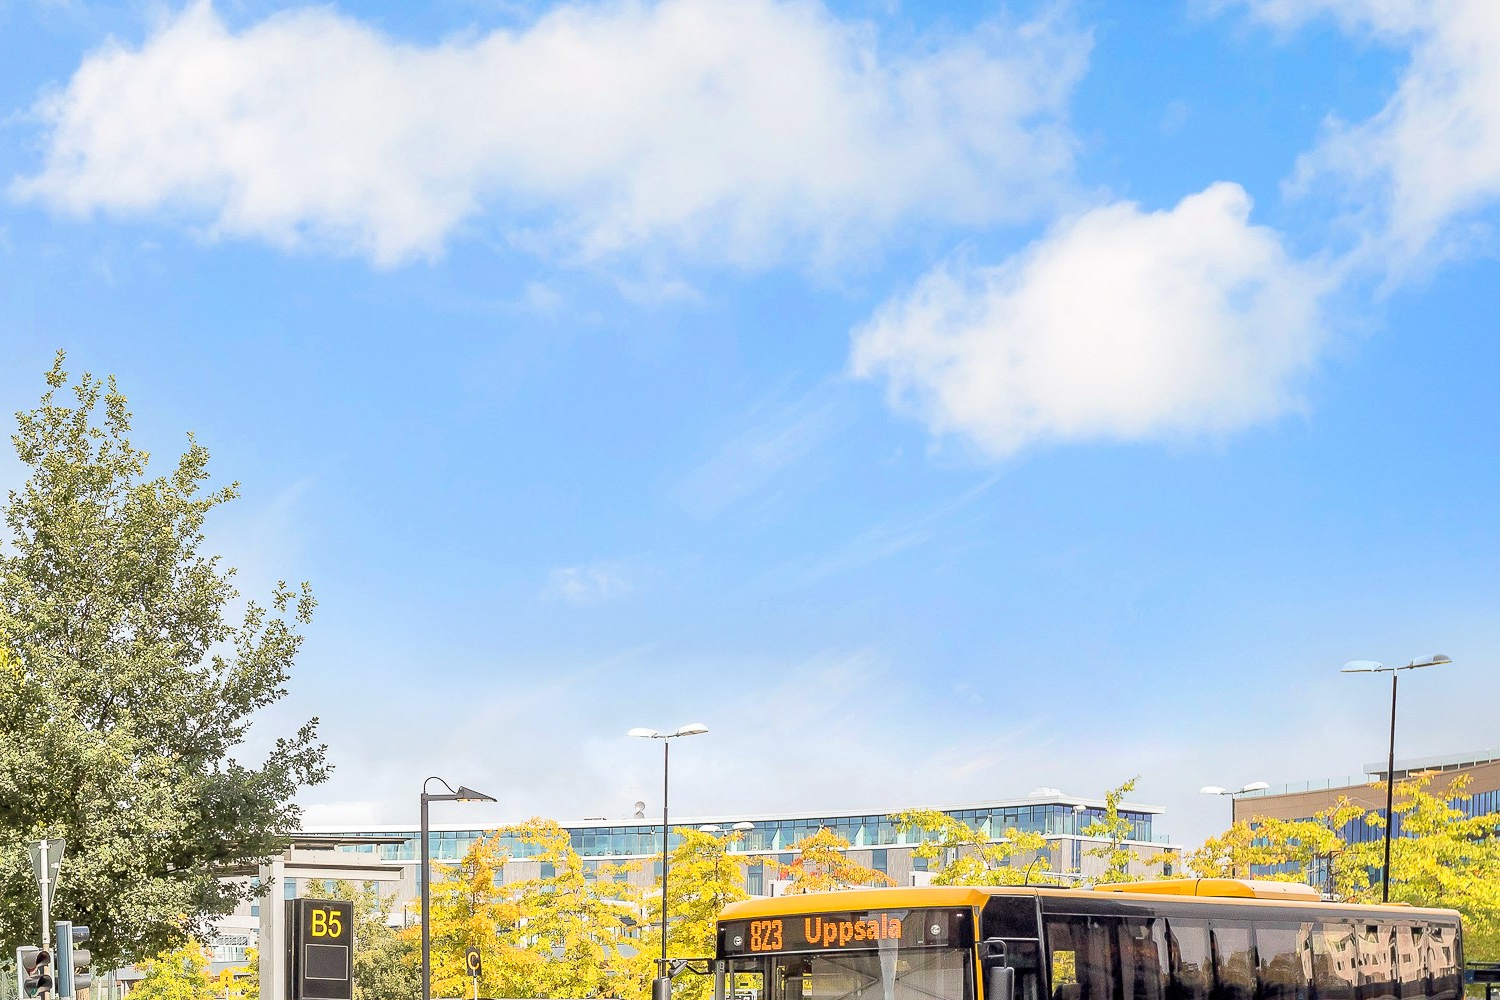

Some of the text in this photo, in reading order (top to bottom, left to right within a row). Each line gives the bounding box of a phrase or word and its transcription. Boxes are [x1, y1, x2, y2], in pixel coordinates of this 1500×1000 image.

[311, 909, 342, 938] B5
[750, 913, 902, 951] 823 Uppsala
[467, 951, 480, 970] C
